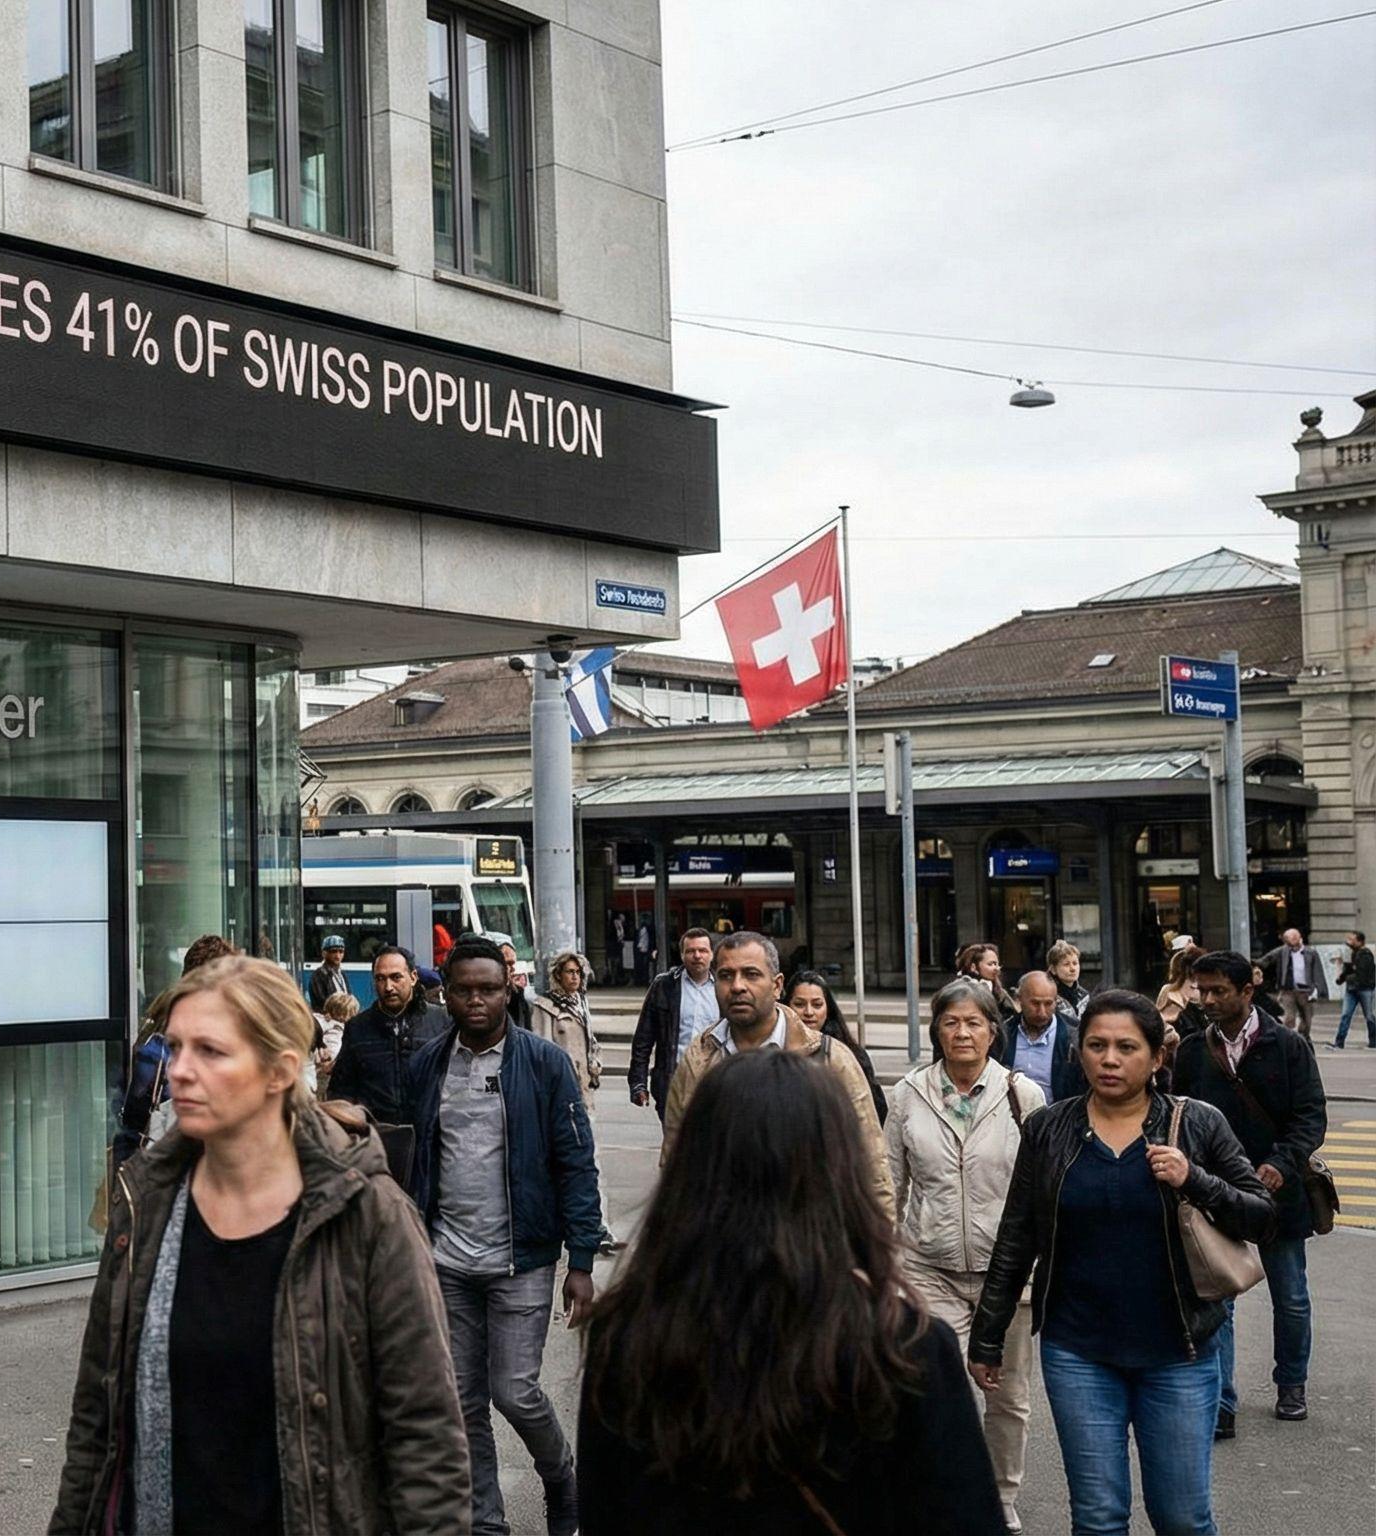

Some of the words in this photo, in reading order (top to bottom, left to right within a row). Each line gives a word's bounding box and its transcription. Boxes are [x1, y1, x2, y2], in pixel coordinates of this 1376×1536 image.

[66, 291, 160, 366] 41%
[174, 314, 230, 378] OF
[243, 329, 371, 410] SWISS
[383, 360, 604, 459] POPULATION
